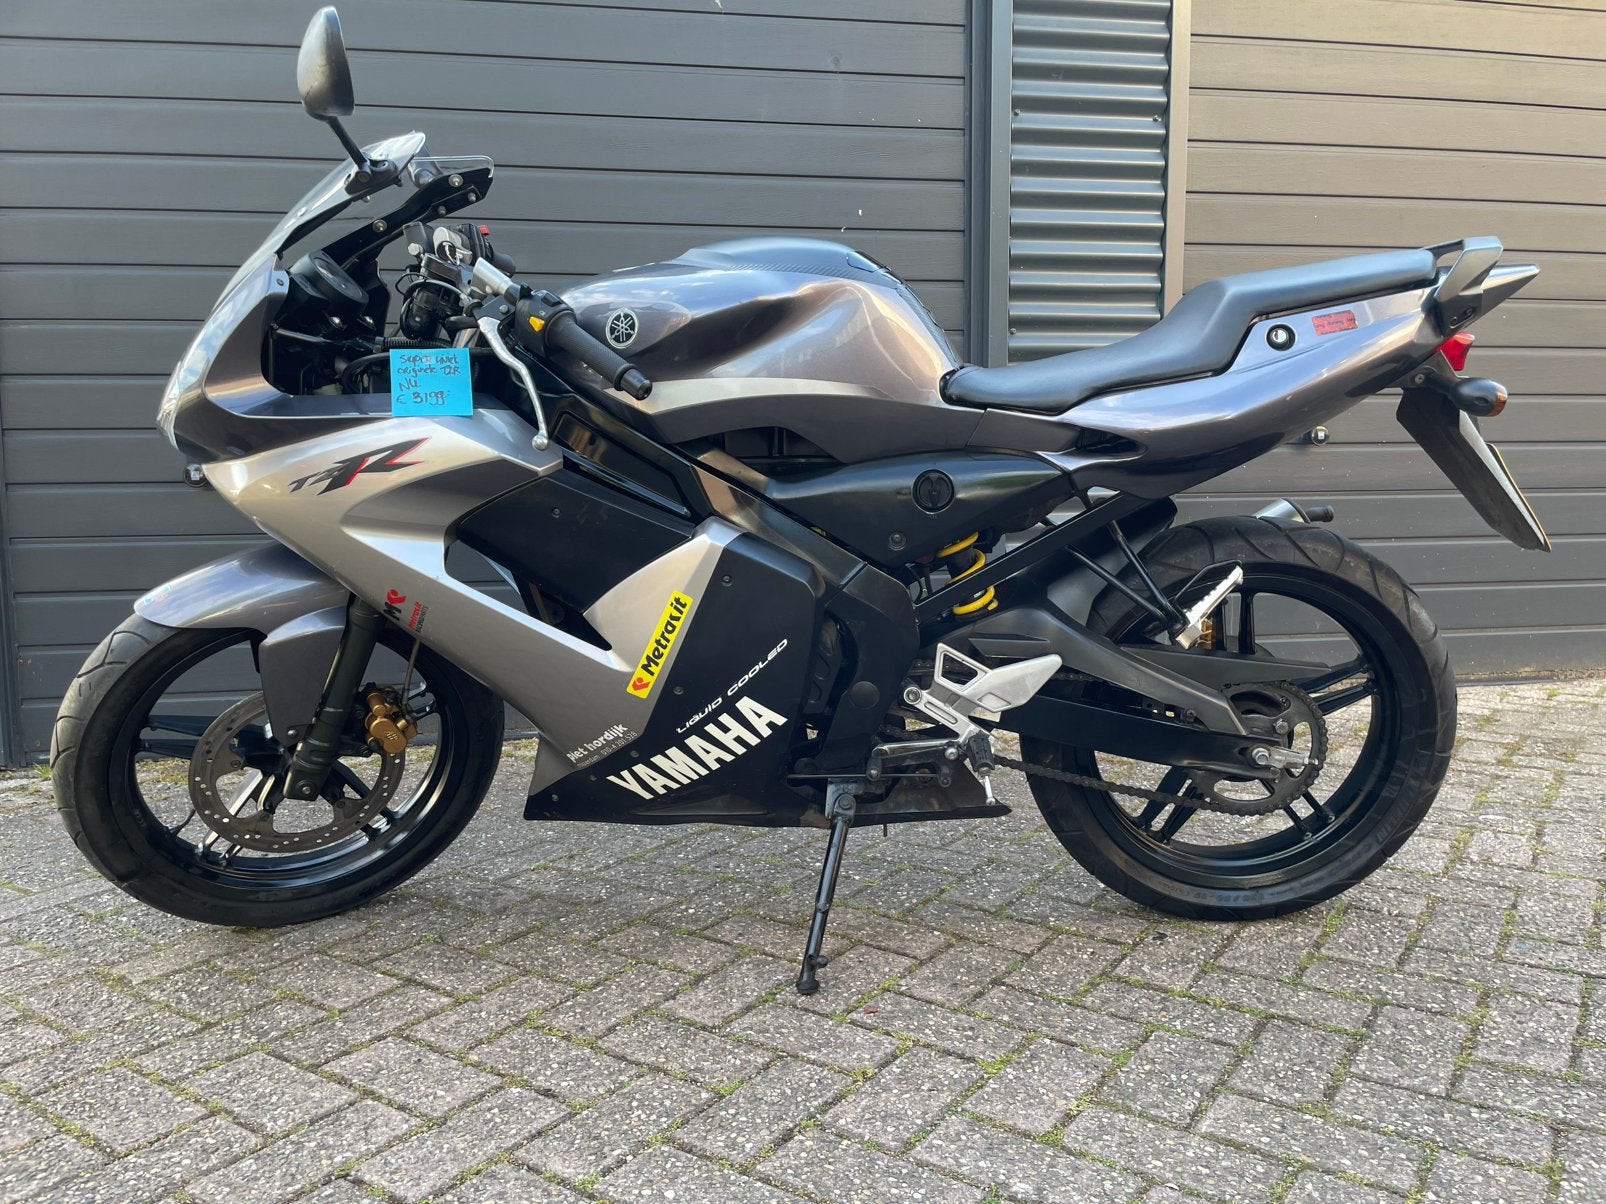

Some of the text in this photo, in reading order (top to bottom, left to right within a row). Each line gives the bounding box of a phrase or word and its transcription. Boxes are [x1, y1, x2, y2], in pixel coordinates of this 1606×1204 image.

[676, 638, 788, 734] LIQUID COOLED
[566, 724, 628, 763] piet hordijk
[606, 695, 789, 800] YAMAHA
